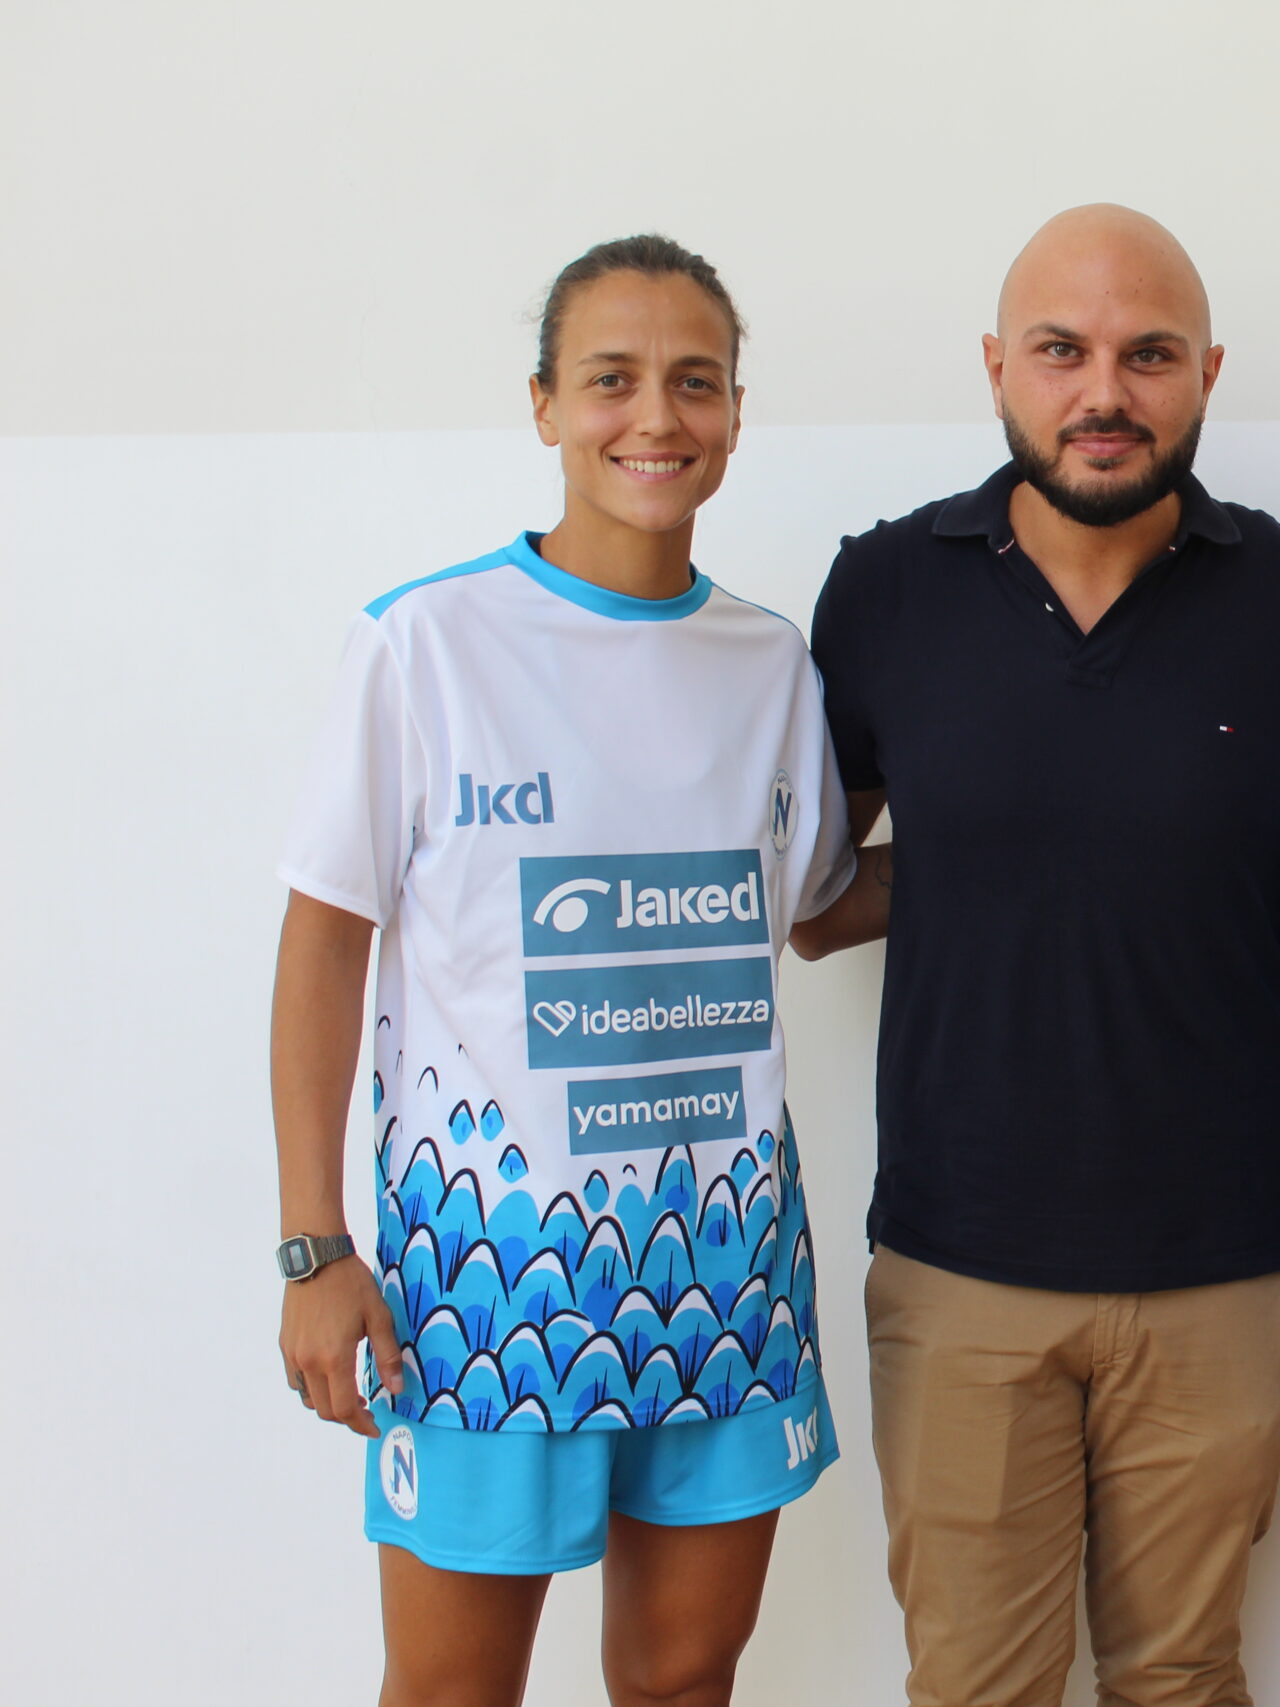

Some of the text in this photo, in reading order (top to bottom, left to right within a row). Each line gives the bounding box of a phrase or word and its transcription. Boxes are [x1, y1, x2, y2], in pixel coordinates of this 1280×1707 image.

[617, 872, 760, 928] Jaked
[581, 994, 769, 1035] ideabellezza
[573, 1089, 740, 1135] yamamay
[393, 1445, 414, 1496] N
